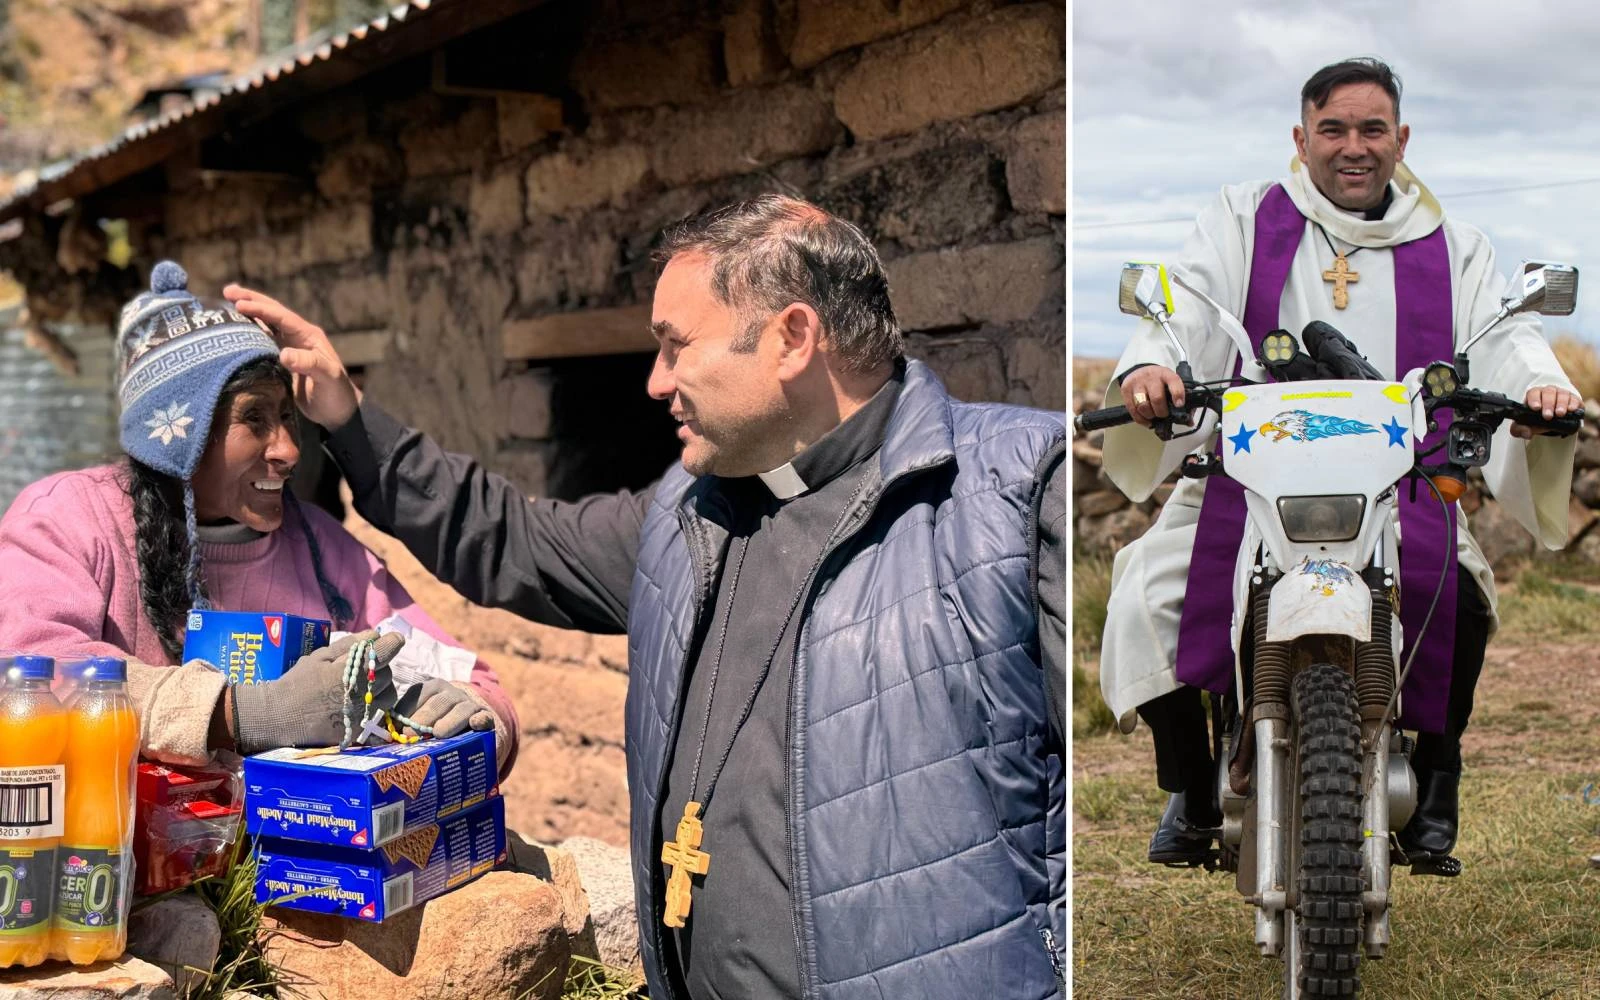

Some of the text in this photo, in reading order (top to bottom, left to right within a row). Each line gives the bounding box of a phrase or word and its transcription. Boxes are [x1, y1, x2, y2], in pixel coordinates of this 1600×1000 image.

[243, 632, 264, 686] Hone
[256, 807, 284, 821] Abeille
[306, 813, 357, 833] HoneyMaid
[26, 828, 31, 836] 9
